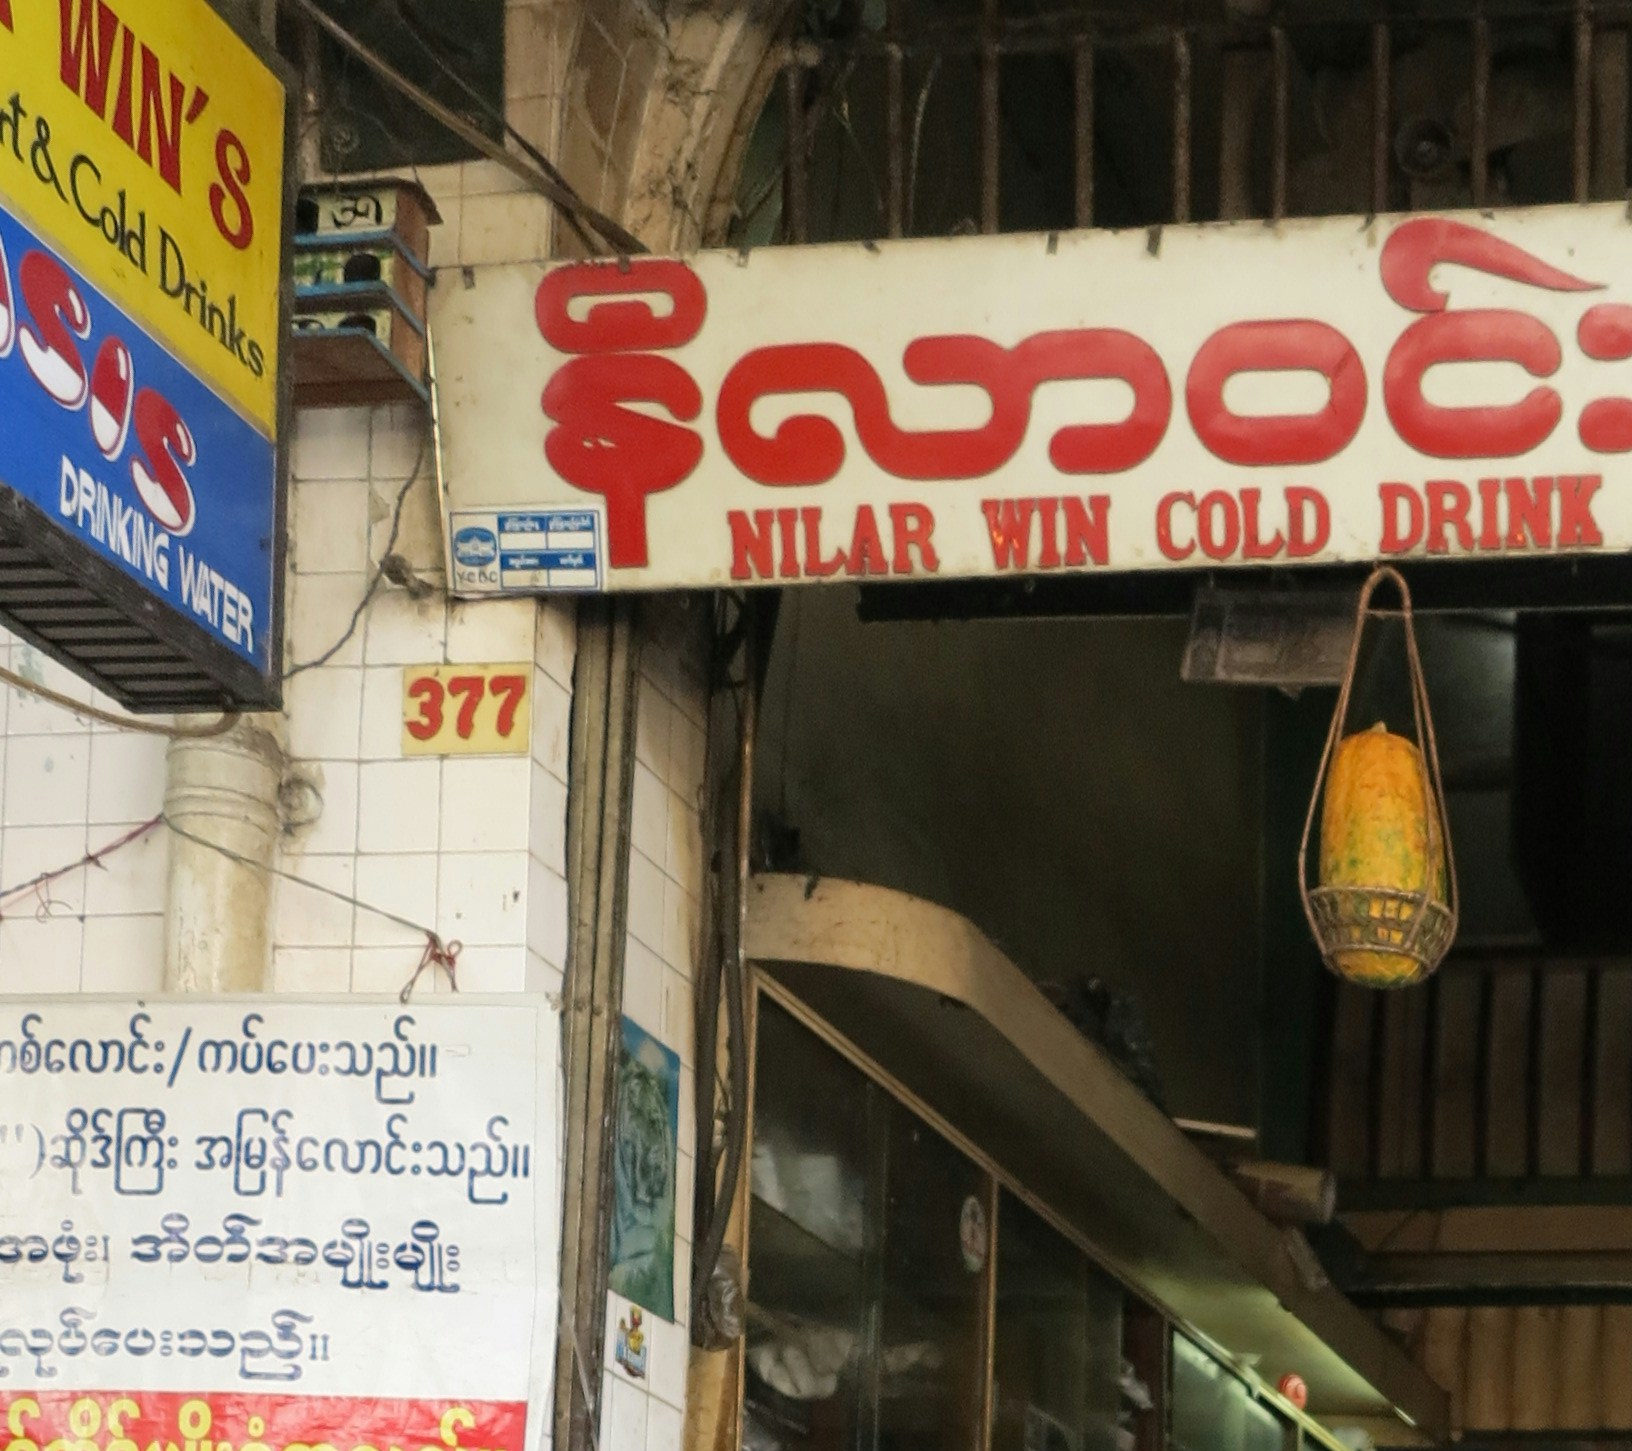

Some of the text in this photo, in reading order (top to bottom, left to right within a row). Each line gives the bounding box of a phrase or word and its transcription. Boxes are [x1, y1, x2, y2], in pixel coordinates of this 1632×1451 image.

[30, 116, 69, 204] &
[69, 153, 147, 275] Cold
[158, 225, 266, 378] Drinks
[59, 455, 255, 653] DRINKING WATER
[726, 501, 941, 582] NILAR
[982, 496, 1111, 569] WIN
[1156, 486, 1331, 562] COLD
[1379, 472, 1605, 556] DRINK
[405, 675, 527, 740] 377
